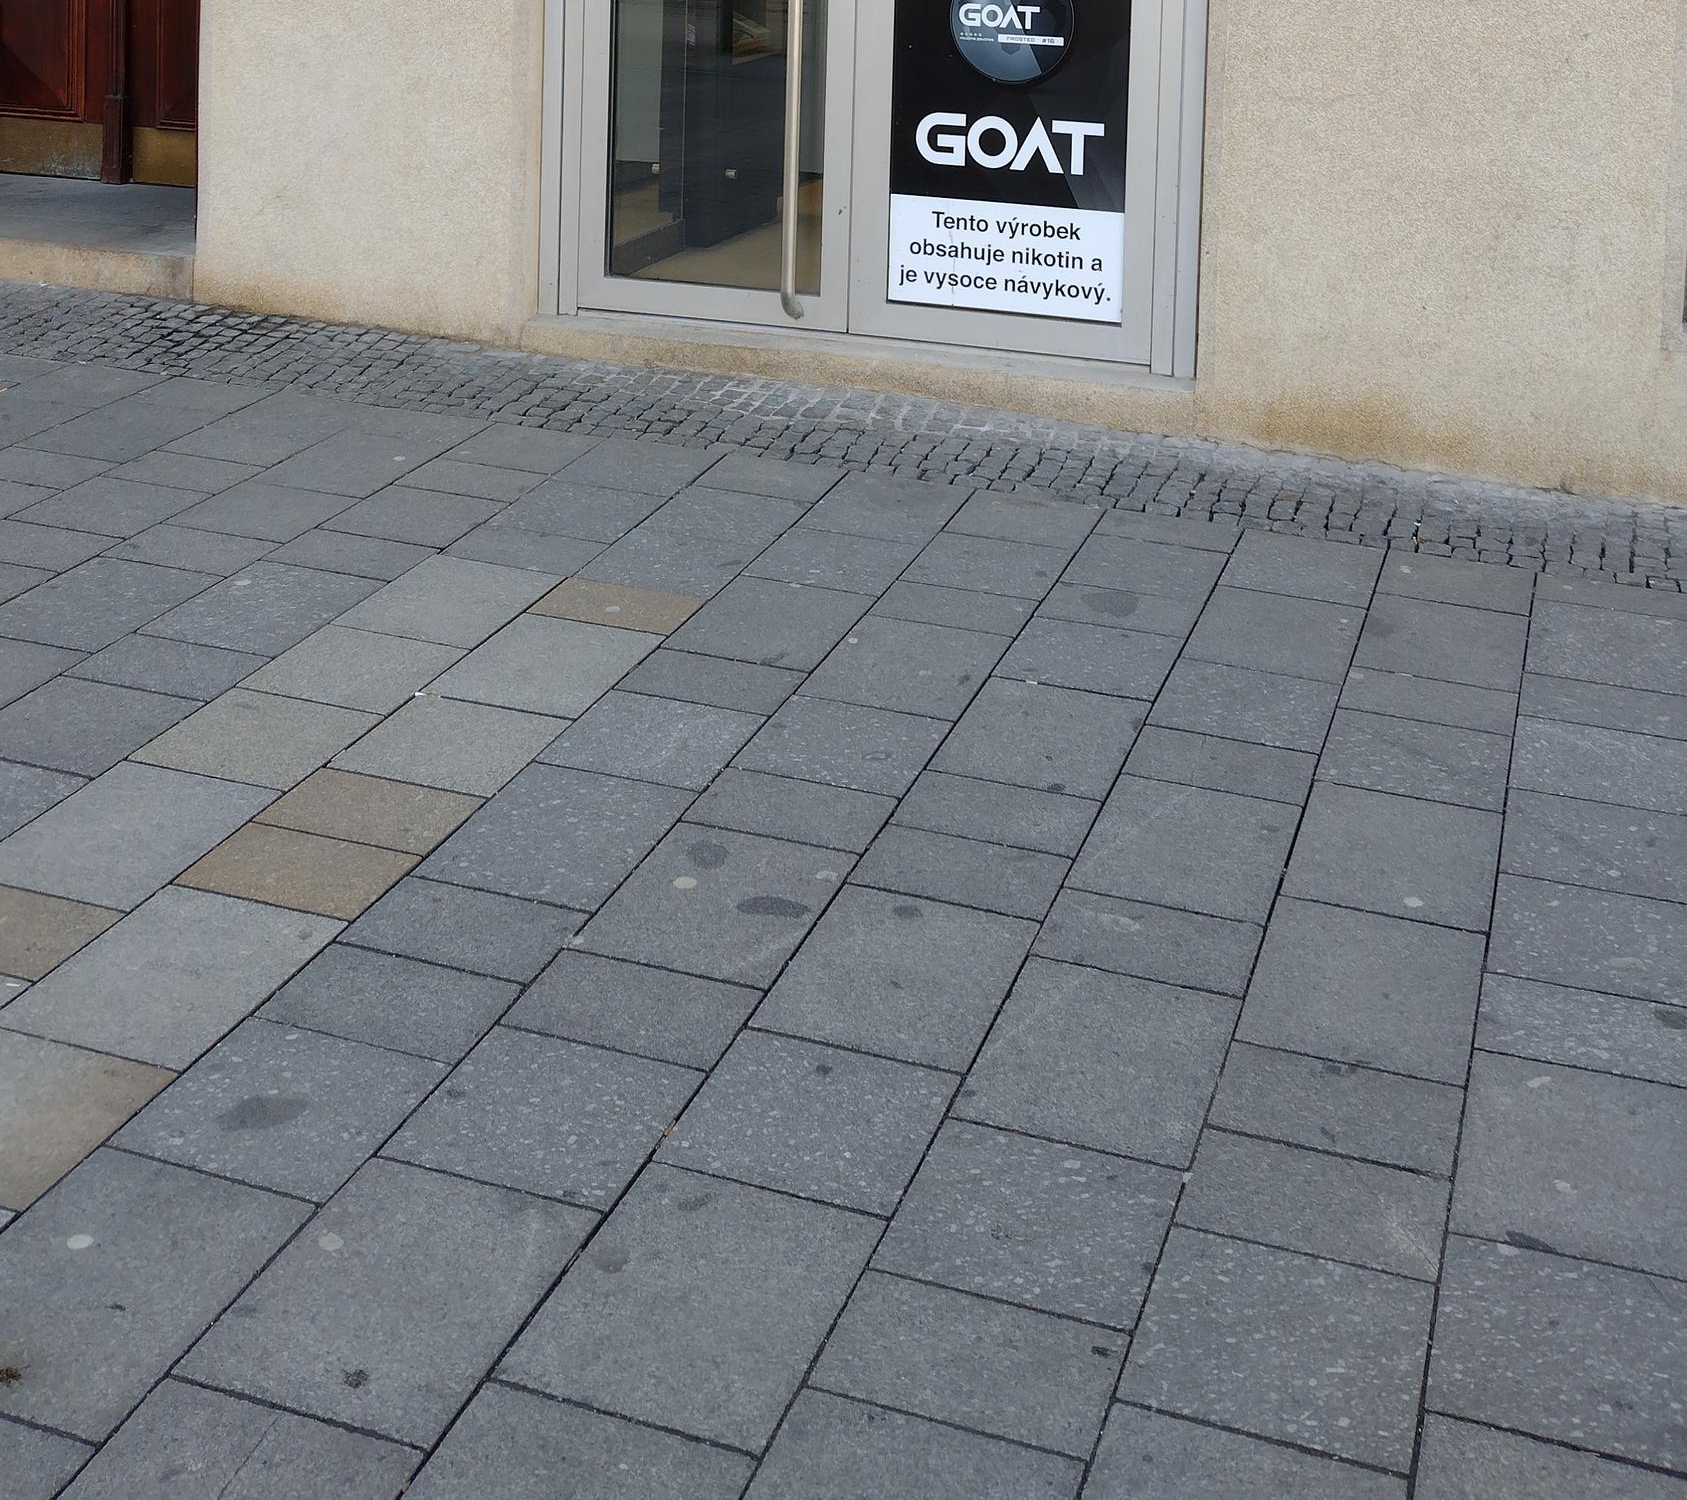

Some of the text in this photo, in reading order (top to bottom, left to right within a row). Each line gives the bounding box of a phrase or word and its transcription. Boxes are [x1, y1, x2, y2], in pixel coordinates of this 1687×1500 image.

[958, 3, 1041, 30] GOAT
[915, 111, 1105, 176] GOAT
[931, 210, 1081, 241] Tento výrobek
[909, 238, 1103, 272] obsahuje nikotin a
[899, 264, 1111, 305] je vysoce návykový.
